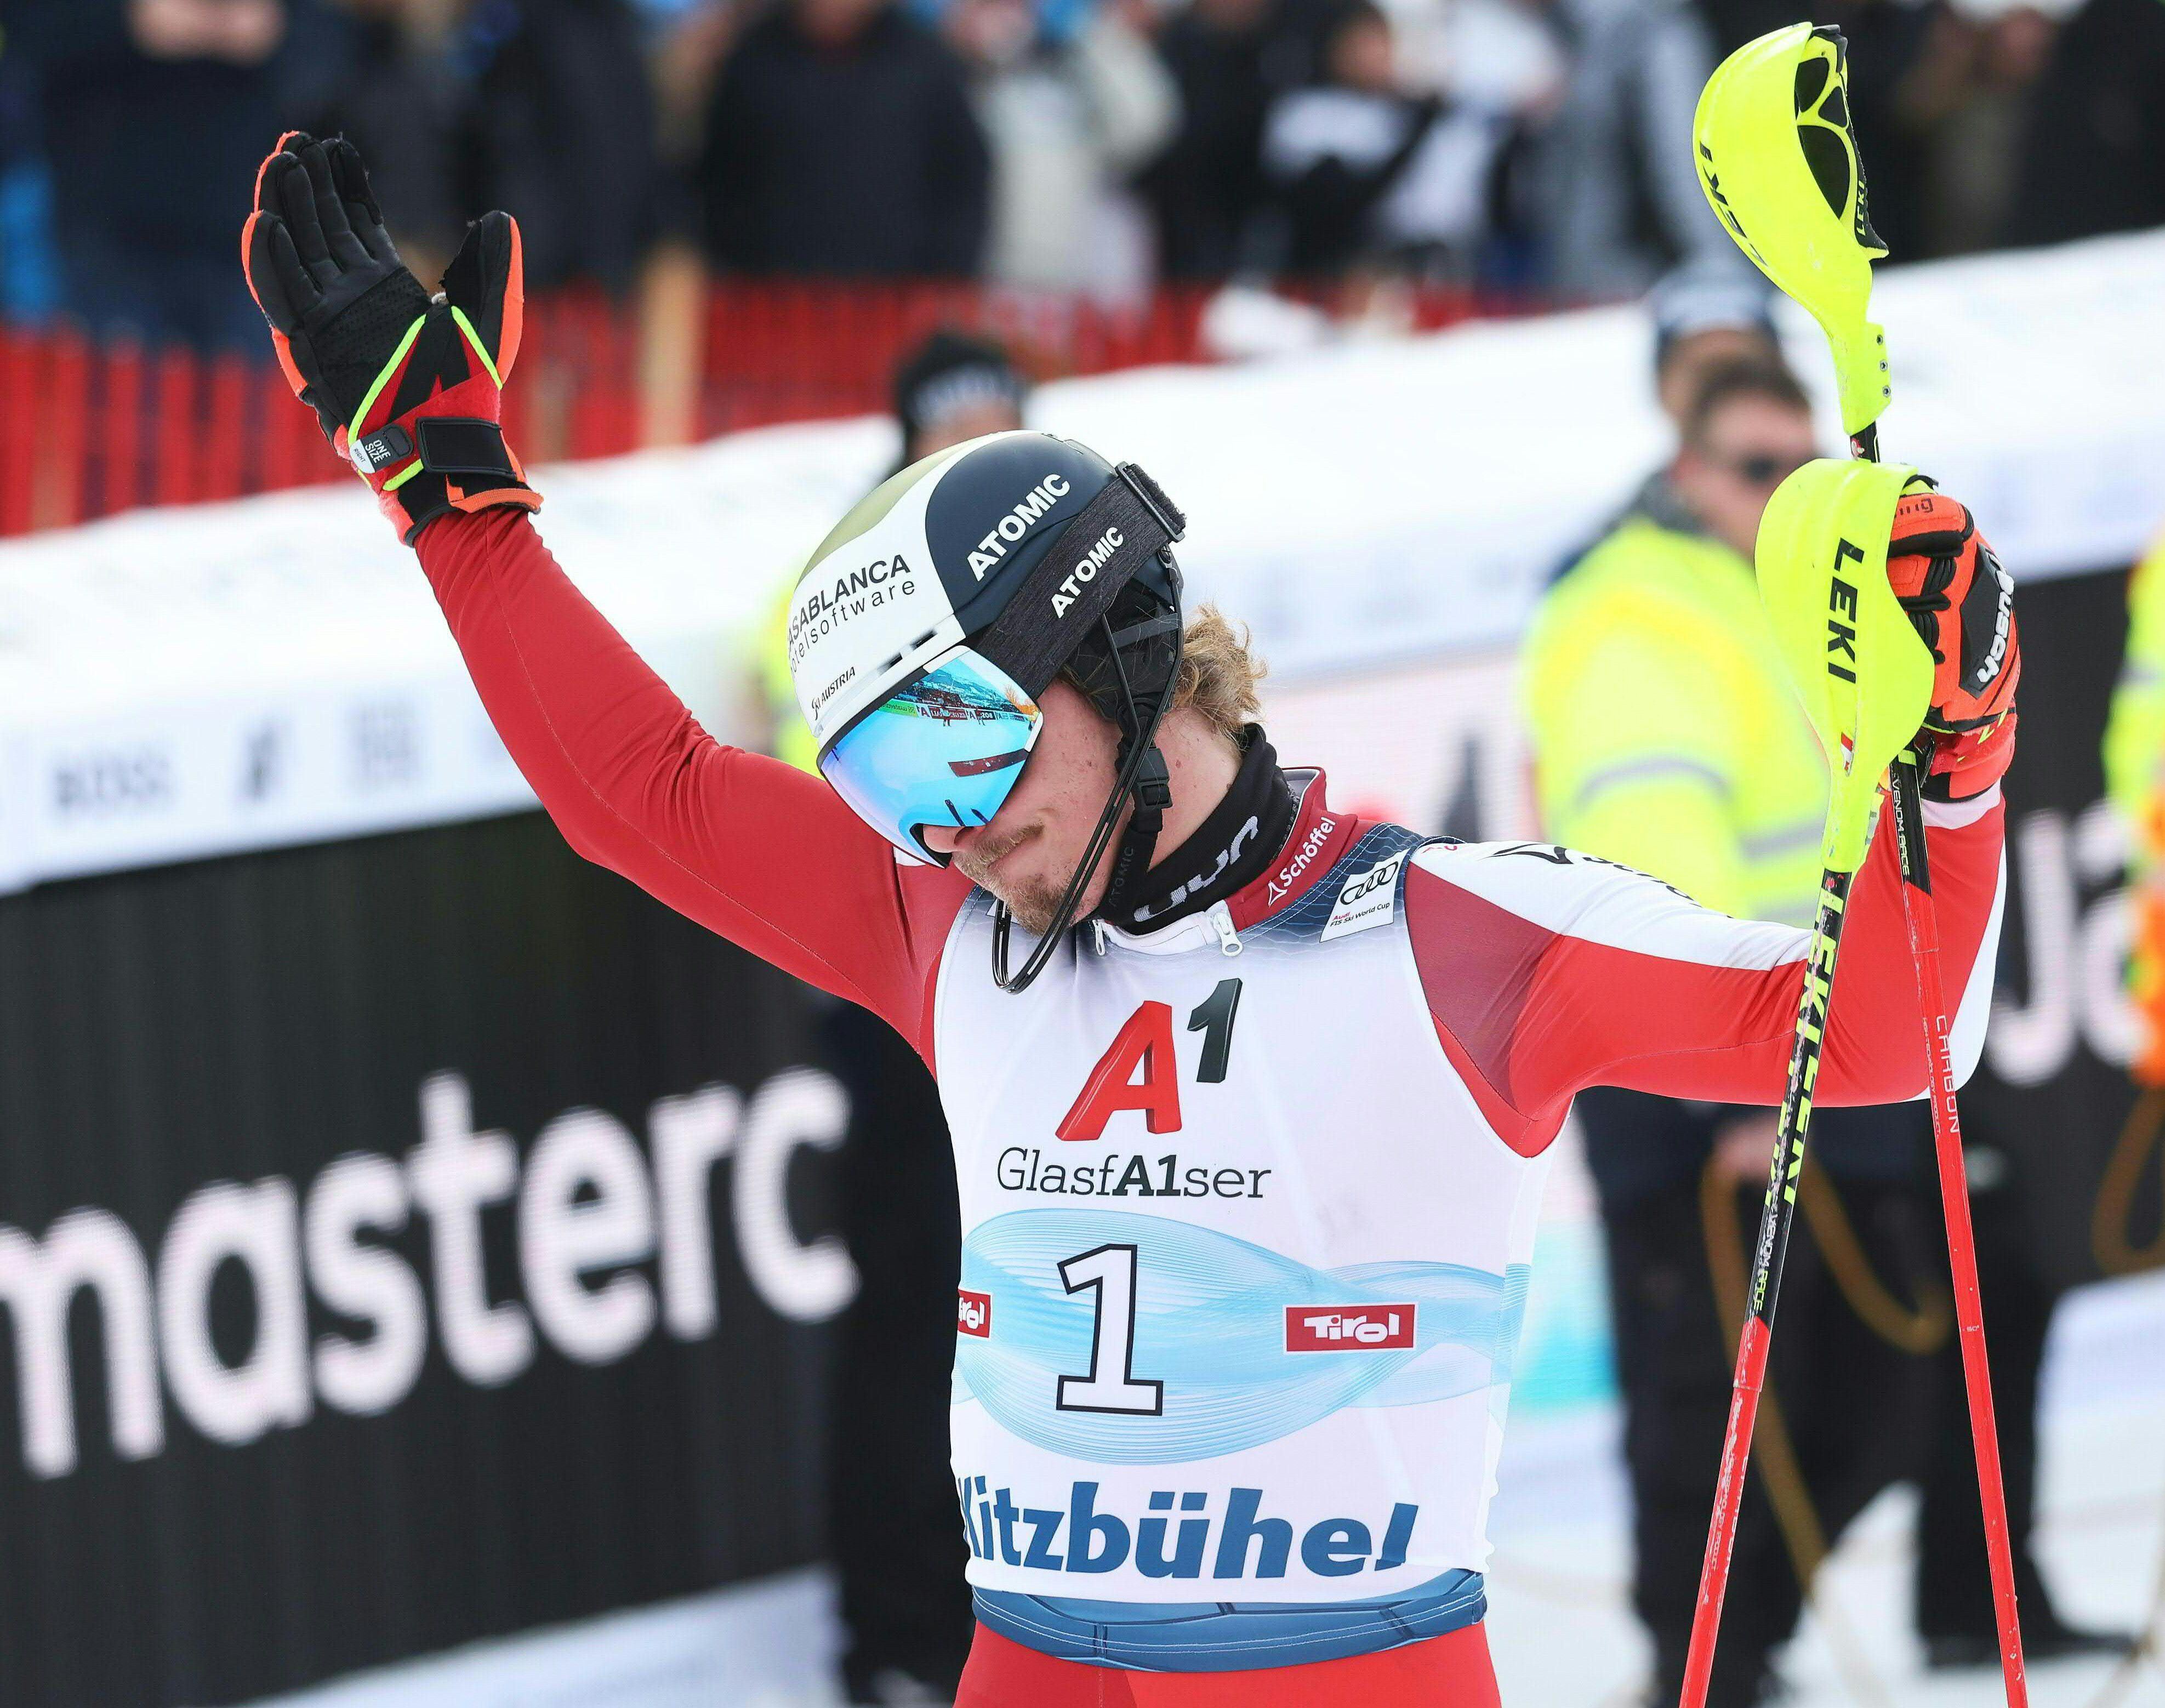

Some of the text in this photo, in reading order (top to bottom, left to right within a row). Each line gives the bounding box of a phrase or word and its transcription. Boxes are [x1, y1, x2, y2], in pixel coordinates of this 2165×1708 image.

[1856, 180, 1866, 236] LEKI
[354, 448, 366, 462] RIGHT
[365, 443, 383, 463] SIZE
[373, 439, 391, 459] ONE
[967, 474, 1070, 582] ATOMIC
[788, 554, 911, 651] ASABLANCA
[1051, 527, 1124, 618] ATOMIC
[789, 580, 915, 673] otelsoftware
[1827, 537, 1865, 684] LEKI
[821, 666, 856, 704] AUSTRIA
[1892, 781, 1904, 831] VENOM
[1279, 817, 1336, 887] Schöffel
[1330, 919, 1342, 927] FIS
[1343, 915, 1354, 923] Ski
[1355, 906, 1376, 919] World
[1333, 912, 1351, 921] Audi
[1796, 887, 1844, 1045] LEKI
[1055, 977, 1243, 1141] A1
[1936, 1015, 1960, 1133] CARBON
[996, 1146, 1272, 1199] GlasfA1ser
[0, 1064, 862, 1481] masterc
[958, 1297, 985, 1330] irol
[1055, 1242, 1164, 1416] 1
[1303, 1311, 1400, 1343] Tirol
[957, 1474, 1418, 1580] Kitzbühel
